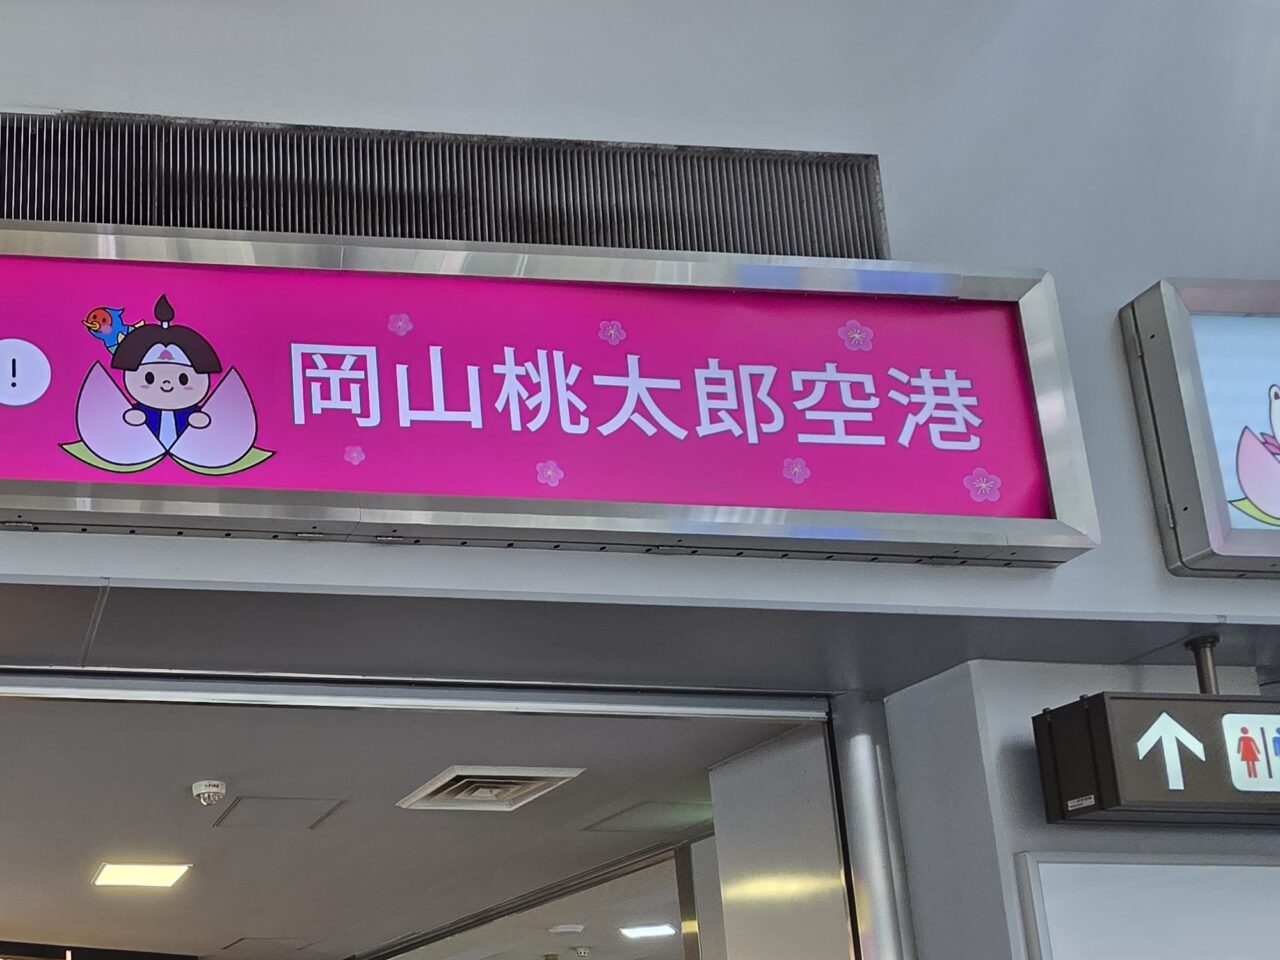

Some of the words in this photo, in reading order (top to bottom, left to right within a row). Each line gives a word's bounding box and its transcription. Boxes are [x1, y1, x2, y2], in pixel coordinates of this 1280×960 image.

[288, 341, 984, 453] 岡山桃太郎空港
